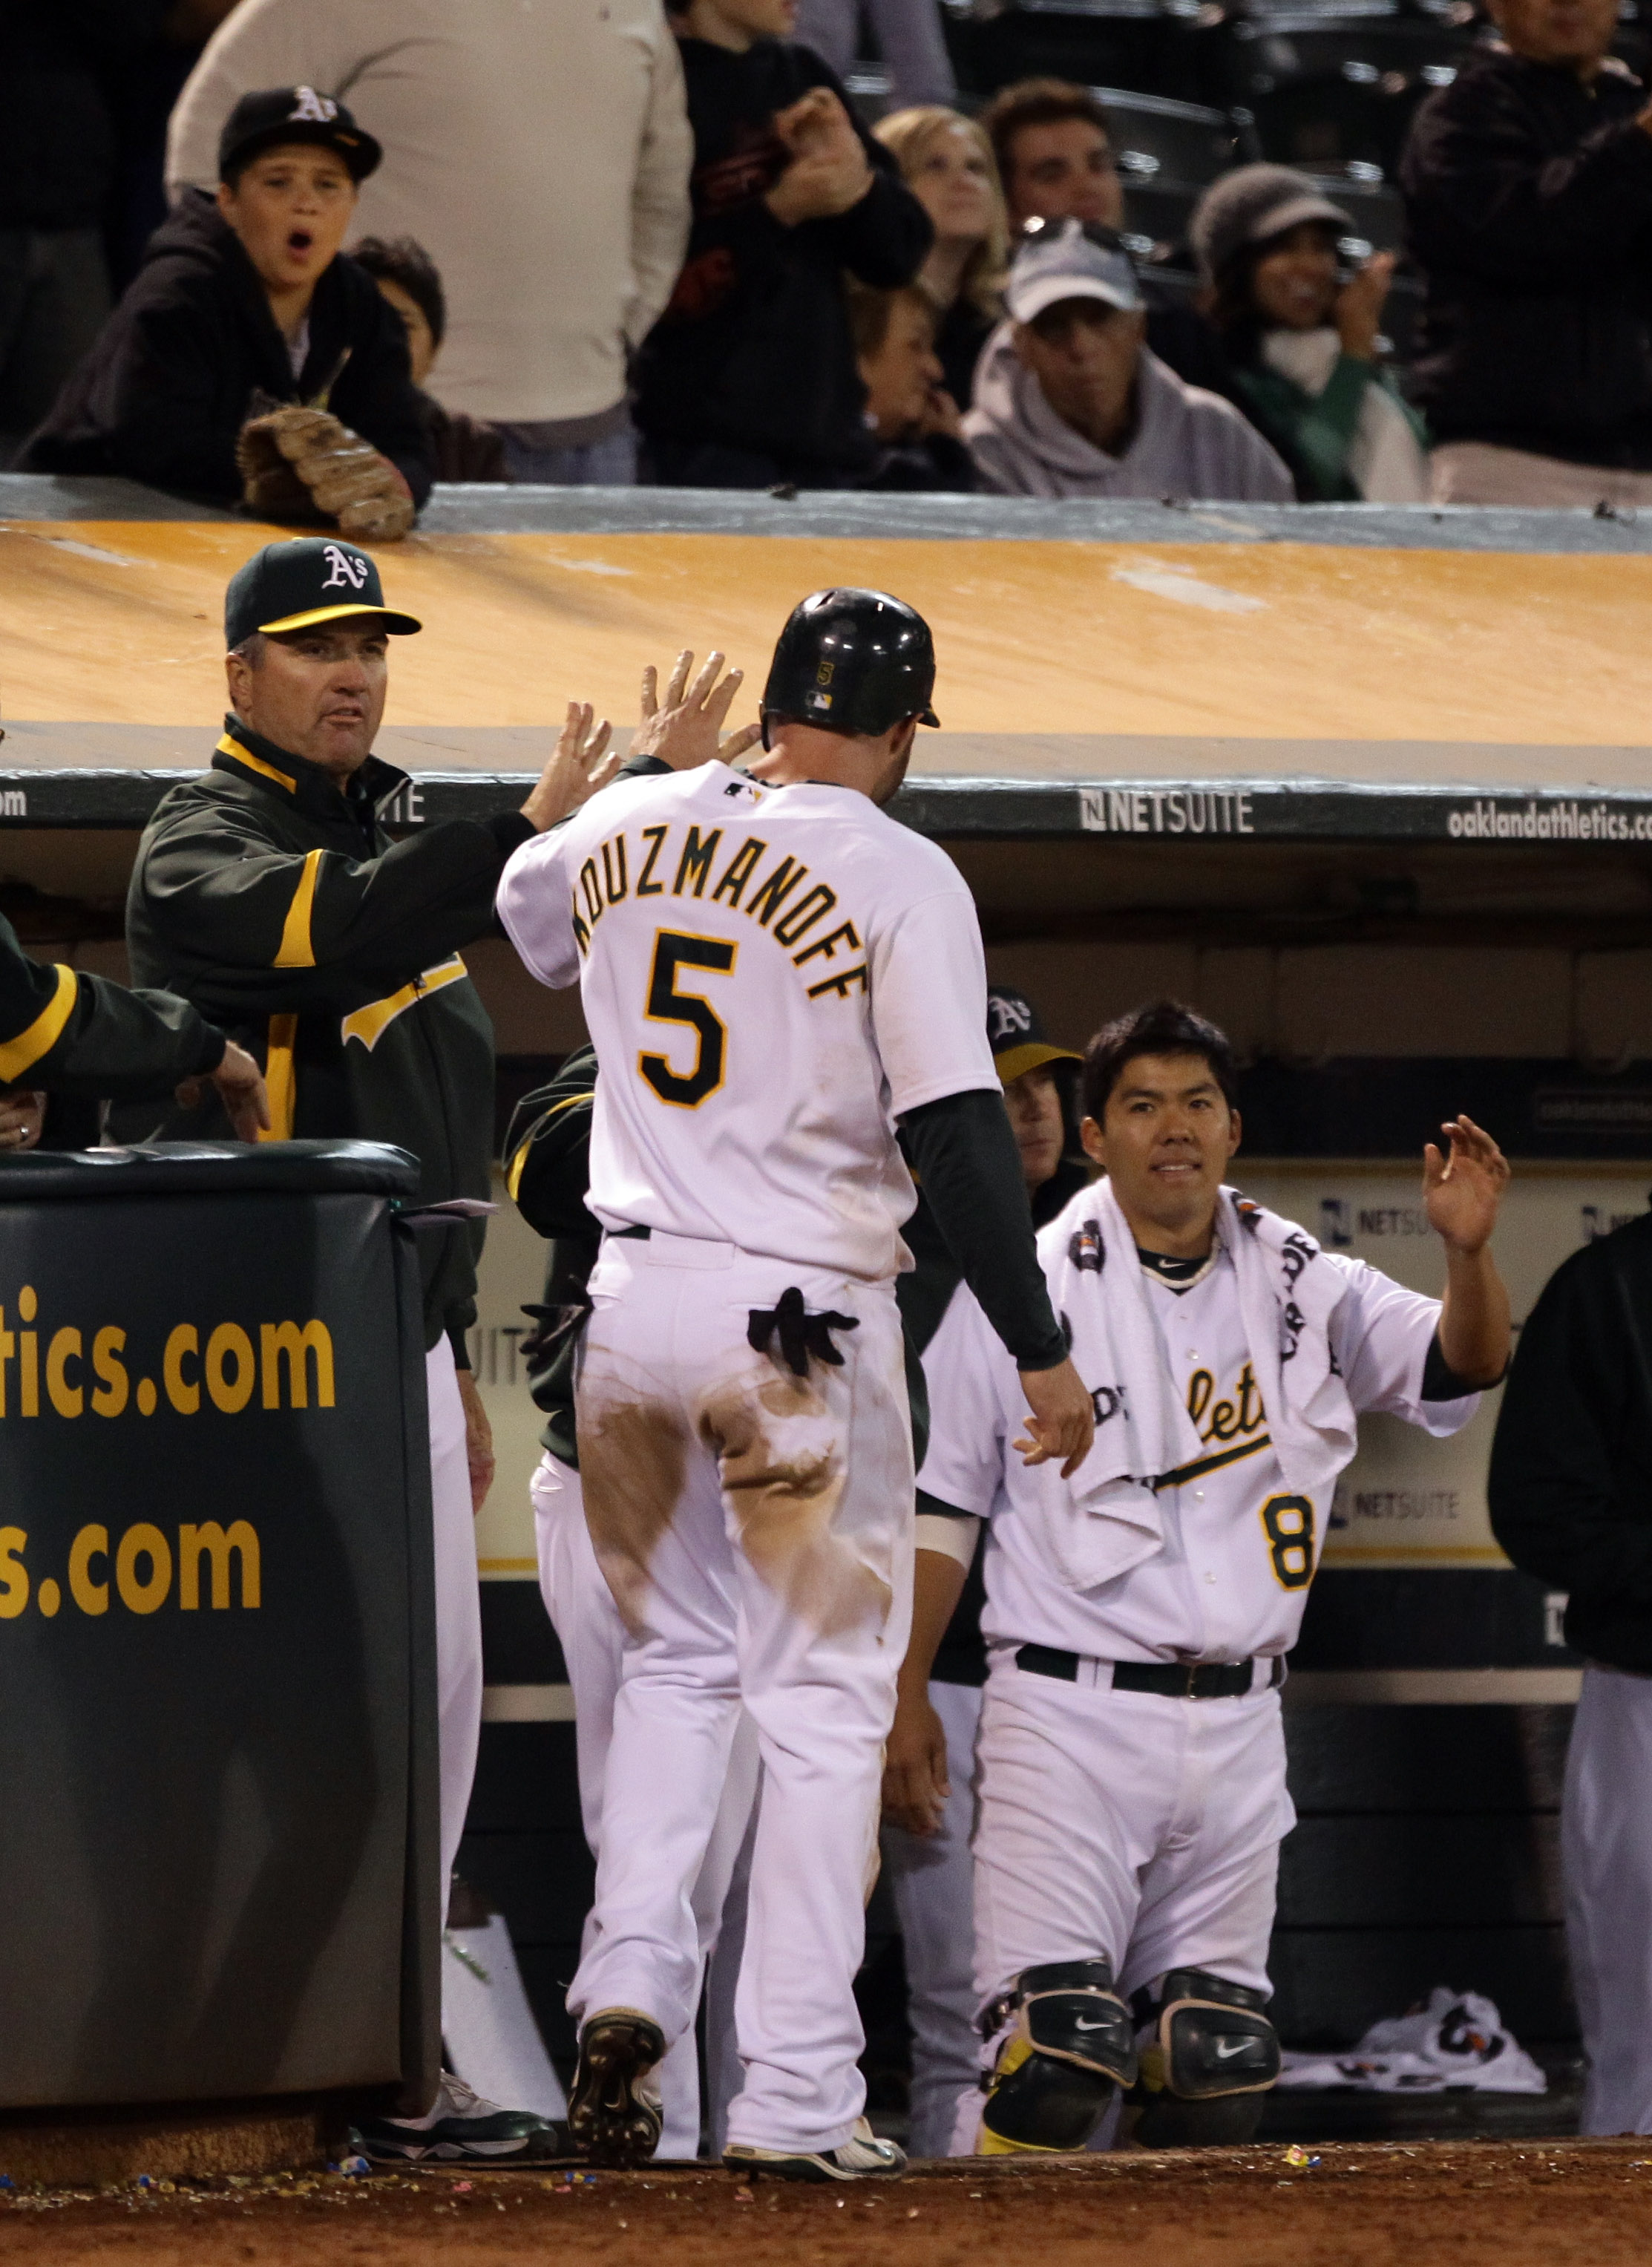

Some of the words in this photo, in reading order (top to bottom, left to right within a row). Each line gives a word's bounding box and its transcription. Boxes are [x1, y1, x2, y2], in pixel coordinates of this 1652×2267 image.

[321, 545, 369, 589] A's
[818, 661, 834, 686] 5
[1109, 790, 1255, 833] NETSUITE
[571, 822, 870, 1002] KOUZMANOFF
[637, 926, 739, 1110] 5
[1354, 1491, 1461, 1519] NETSUITE
[0, 1519, 261, 1619] s.com
[1259, 1492, 1317, 1592] 8
